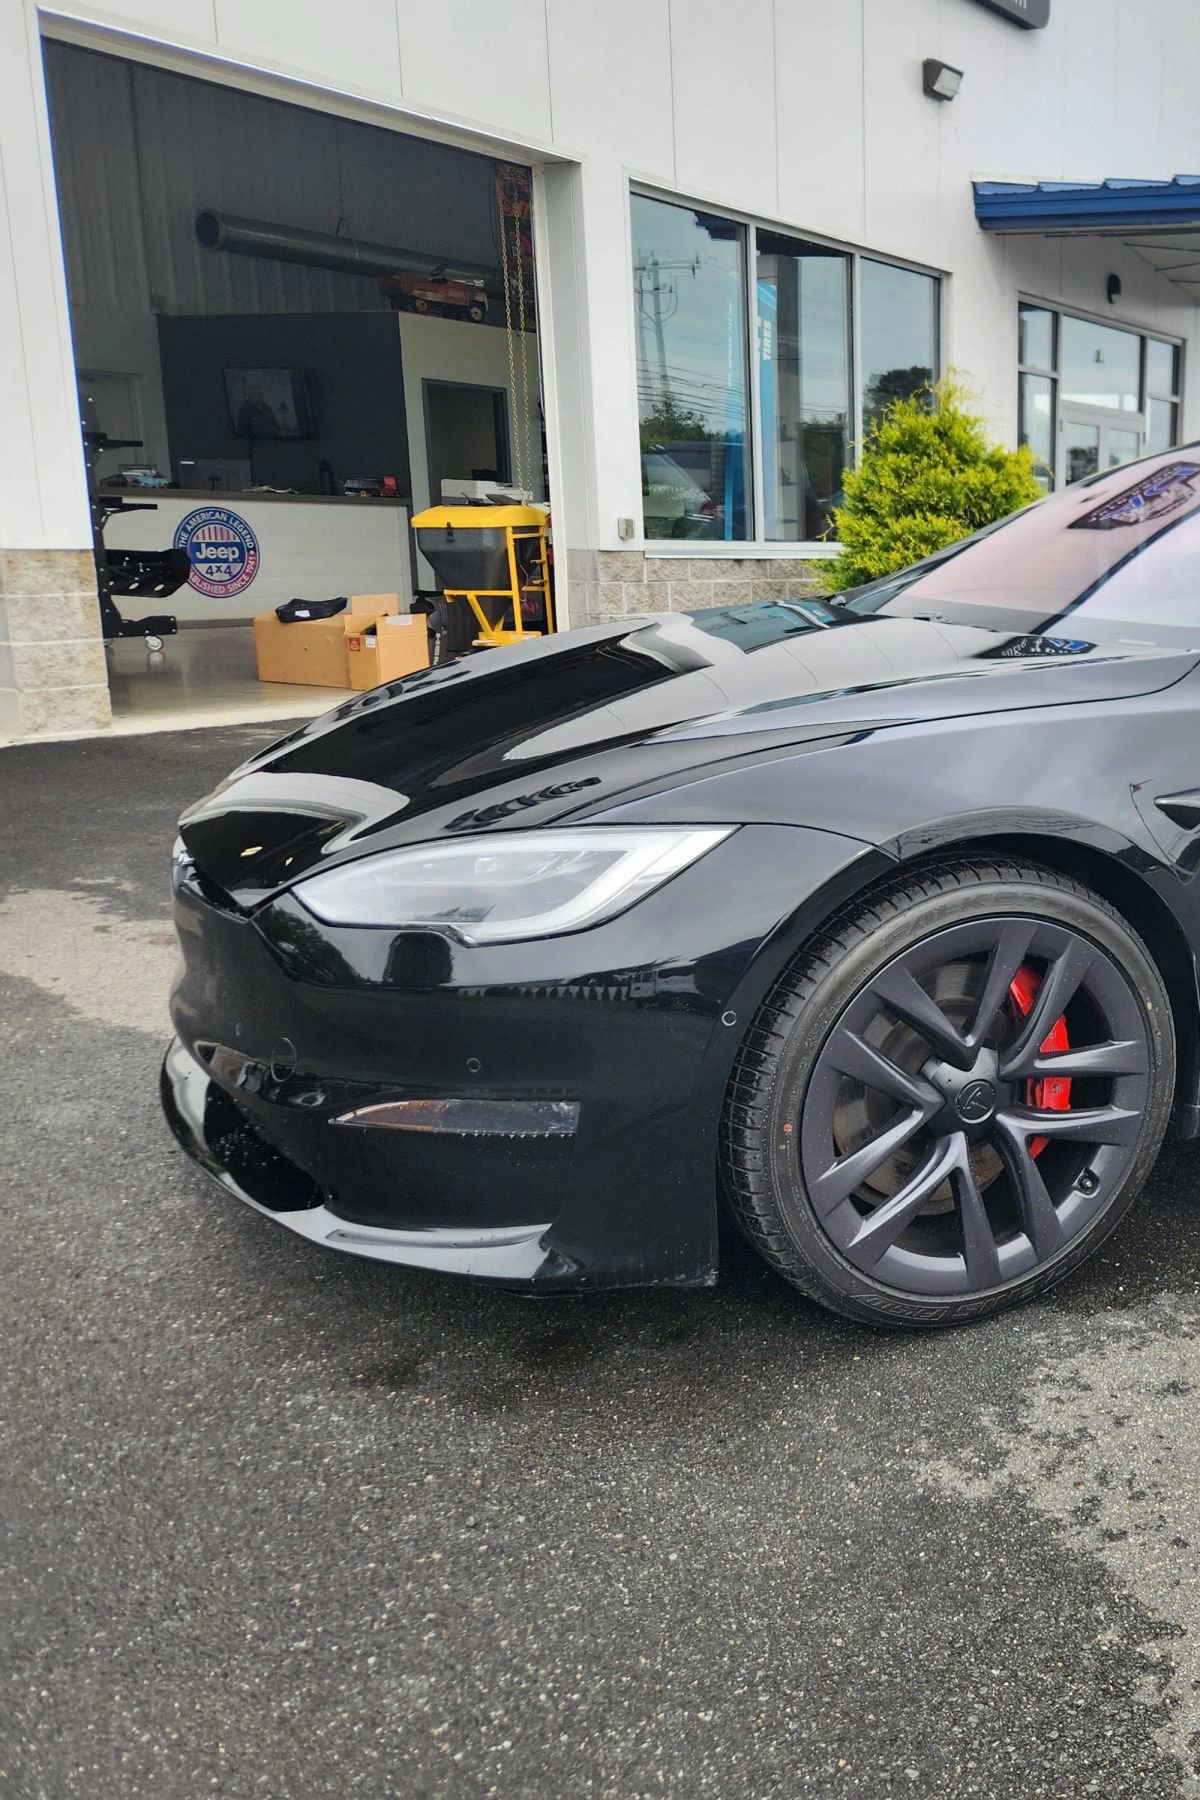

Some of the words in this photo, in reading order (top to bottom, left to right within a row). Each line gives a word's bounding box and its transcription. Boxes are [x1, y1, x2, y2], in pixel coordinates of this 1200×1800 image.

[763, 320, 771, 360] TIRES
[179, 531, 189, 548] THE
[185, 511, 228, 532] AMERICAN
[229, 517, 255, 549] LEGEND
[195, 543, 240, 562] Jeep
[189, 570, 225, 594] ABLISHED
[228, 575, 250, 593] SINCE
[245, 556, 257, 574] 1941
